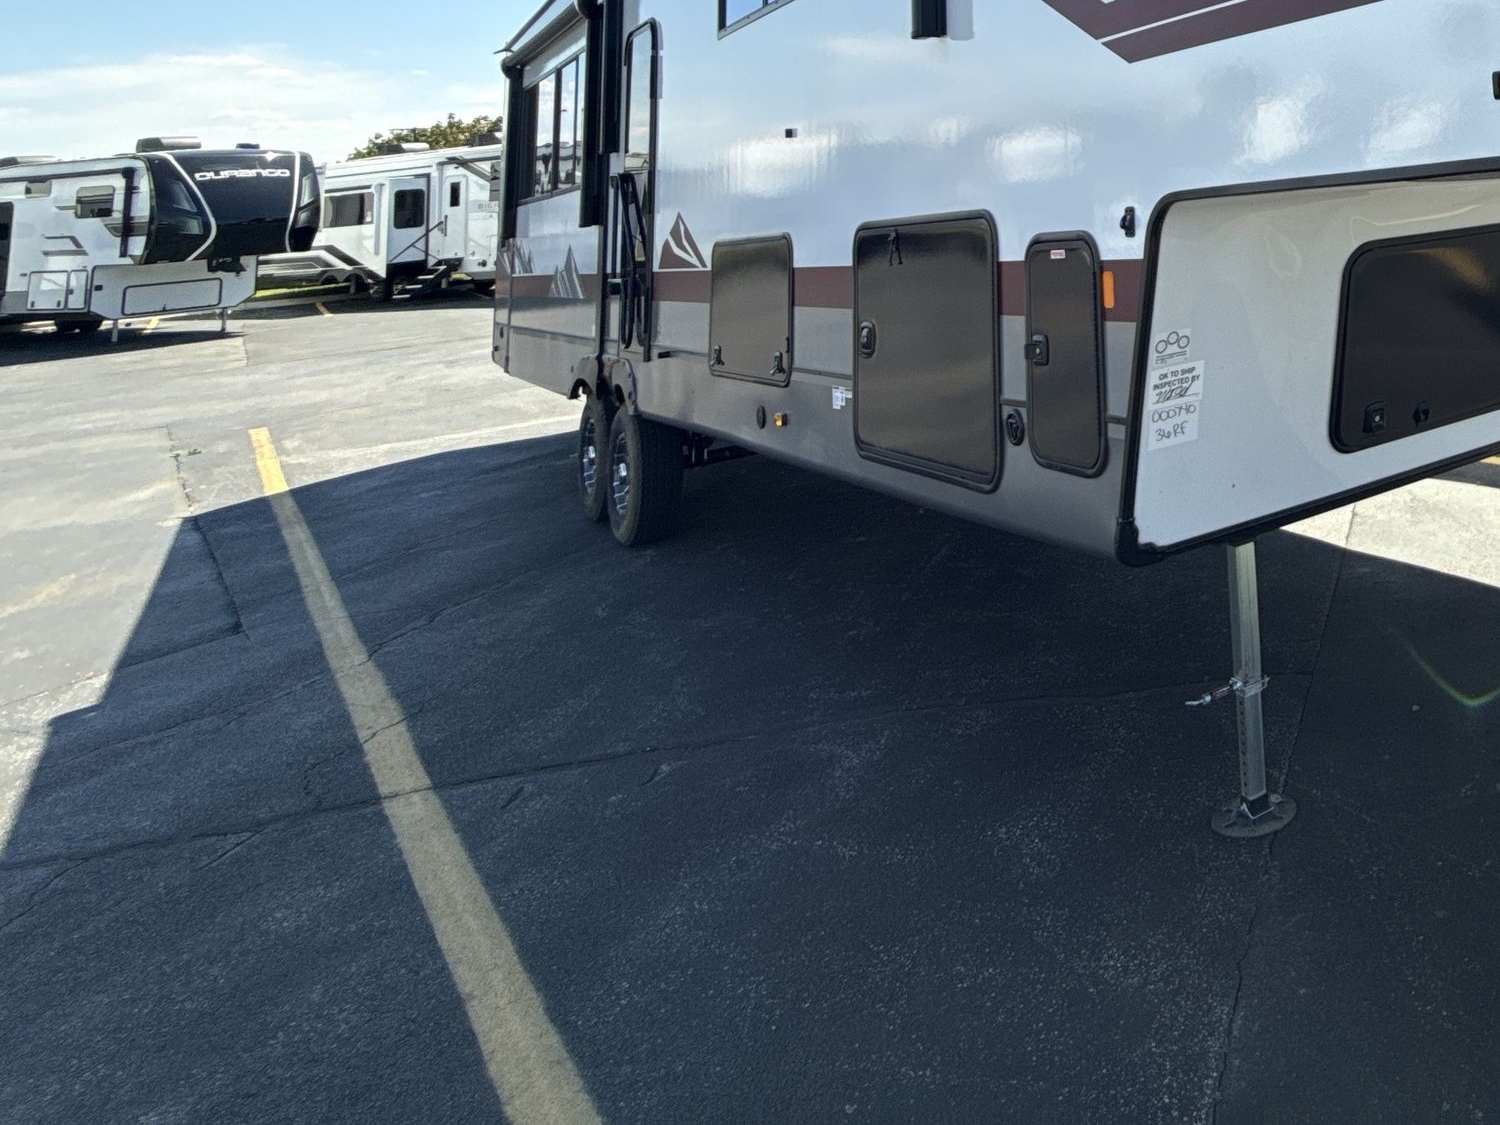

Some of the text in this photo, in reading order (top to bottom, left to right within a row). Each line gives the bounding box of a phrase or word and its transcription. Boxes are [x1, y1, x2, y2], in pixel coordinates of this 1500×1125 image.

[194, 168, 291, 181] DURANGO
[1159, 373, 1168, 381] OK
[1181, 366, 1196, 375] SHIP
[1153, 376, 1190, 391] INSPECTED
